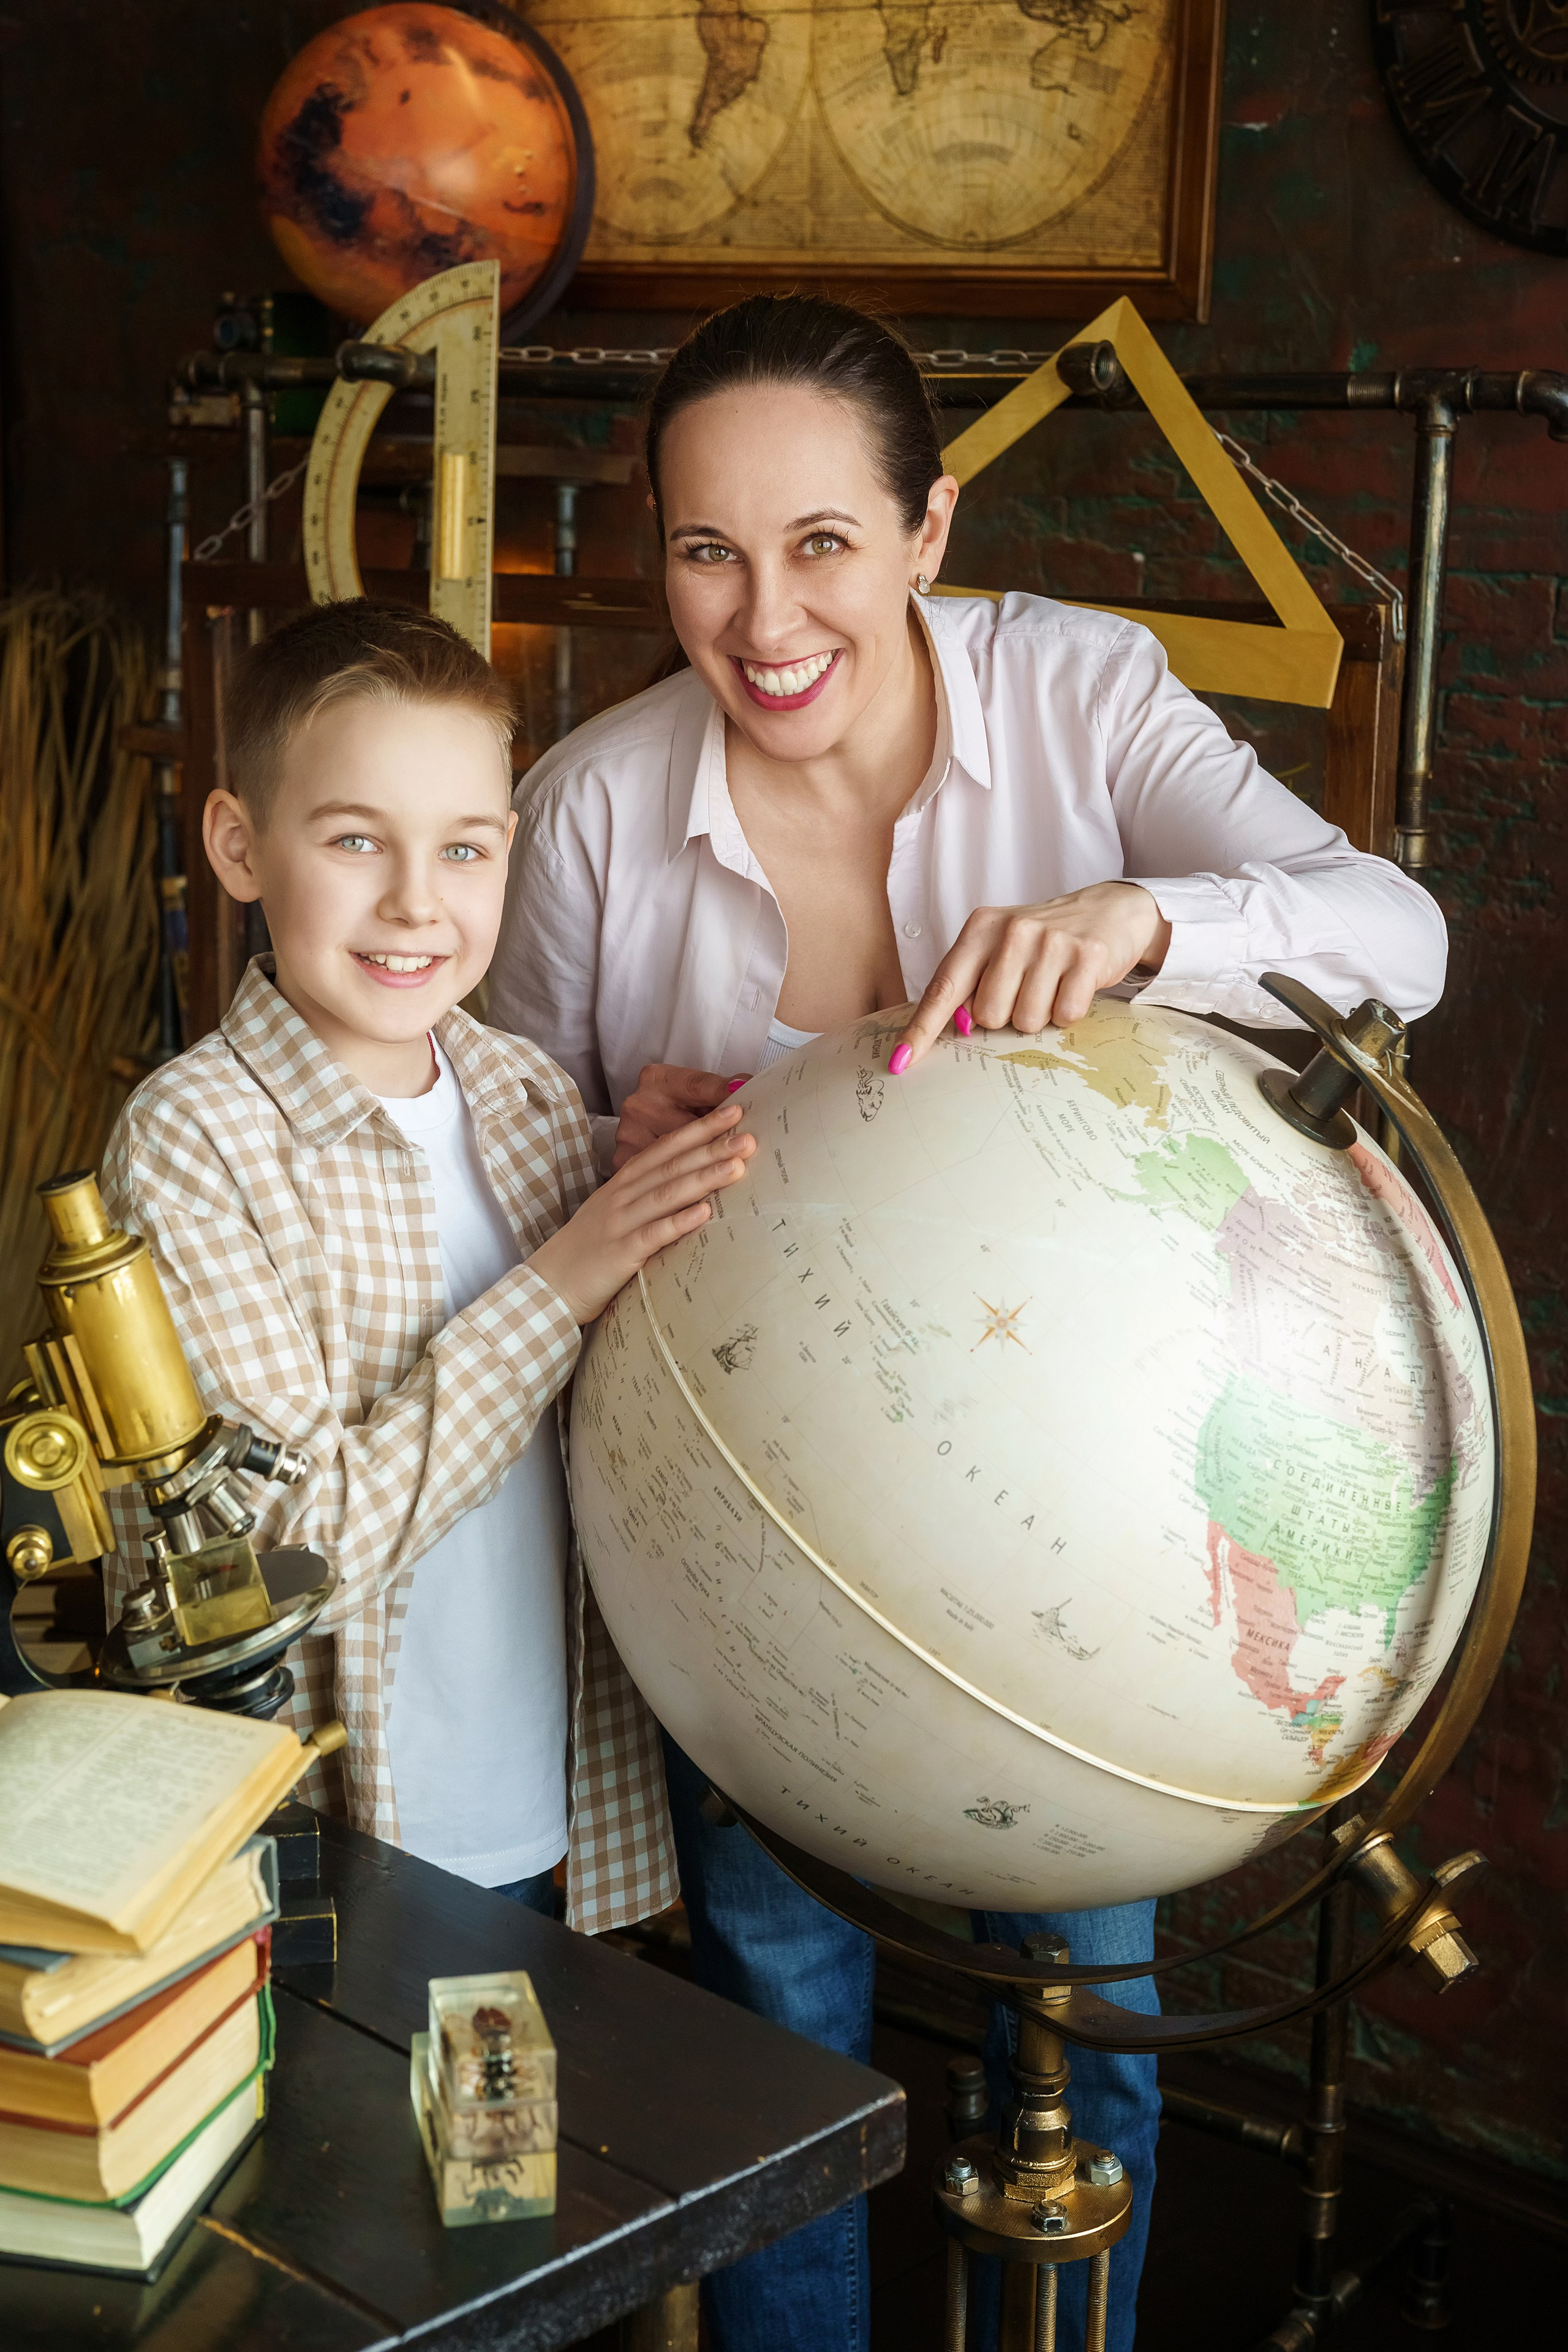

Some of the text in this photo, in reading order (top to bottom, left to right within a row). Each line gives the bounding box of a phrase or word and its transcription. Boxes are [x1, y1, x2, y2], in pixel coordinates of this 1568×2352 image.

[1170, 1102, 1185, 1118] МОРЕ
[1174, 1093, 1199, 1125] ЧУКОТСКОЕ
[1179, 1077, 1219, 1128] -СИБИРСКОЕ МОРЕ
[1191, 1085, 1216, 1118] ВОСТОЧНО-
[1211, 1089, 1233, 1115] ОКЕАН
[1215, 1069, 1272, 1145] СЕВЕРНЫЙ ЛЕДОВИТЫЙ
[1057, 1113, 1076, 1134] МОРЕ
[1066, 1099, 1098, 1141] БЕРИНГОВО
[1231, 1139, 1281, 1183] МОРЕ БОФОРТА
[1234, 1218, 1257, 1237] Доусон
[881, 1298, 907, 1331] Гавайские
[631, 1375, 642, 1397] ТУВАЛУ
[771, 1218, 1068, 1555] ТИХИЙ ОКЕАН
[1383, 1384, 1413, 1397] ОНТАРИО
[612, 1415, 623, 1437] ФИДЖИ
[655, 1465, 669, 1487] САМОА
[1273, 1458, 1402, 1512] СОЕДИНЕННЫЕ
[627, 1505, 639, 1528] ТОНГА
[713, 1485, 743, 1523] КИРИБАТИ
[1291, 1504, 1351, 1534] ШТАТЫ
[1270, 1520, 1353, 1561] АМЕРИКИ
[680, 1557, 710, 1598] Острова Кука
[1245, 1628, 1291, 1653] МЕКСИКА
[754, 1713, 839, 1783] ФРАНЦУЗСКАЯ ПОЛИНЕЗИЯ
[781, 1785, 868, 1848] ТИХИЙ
[886, 1856, 975, 1896] ОКЕАН
